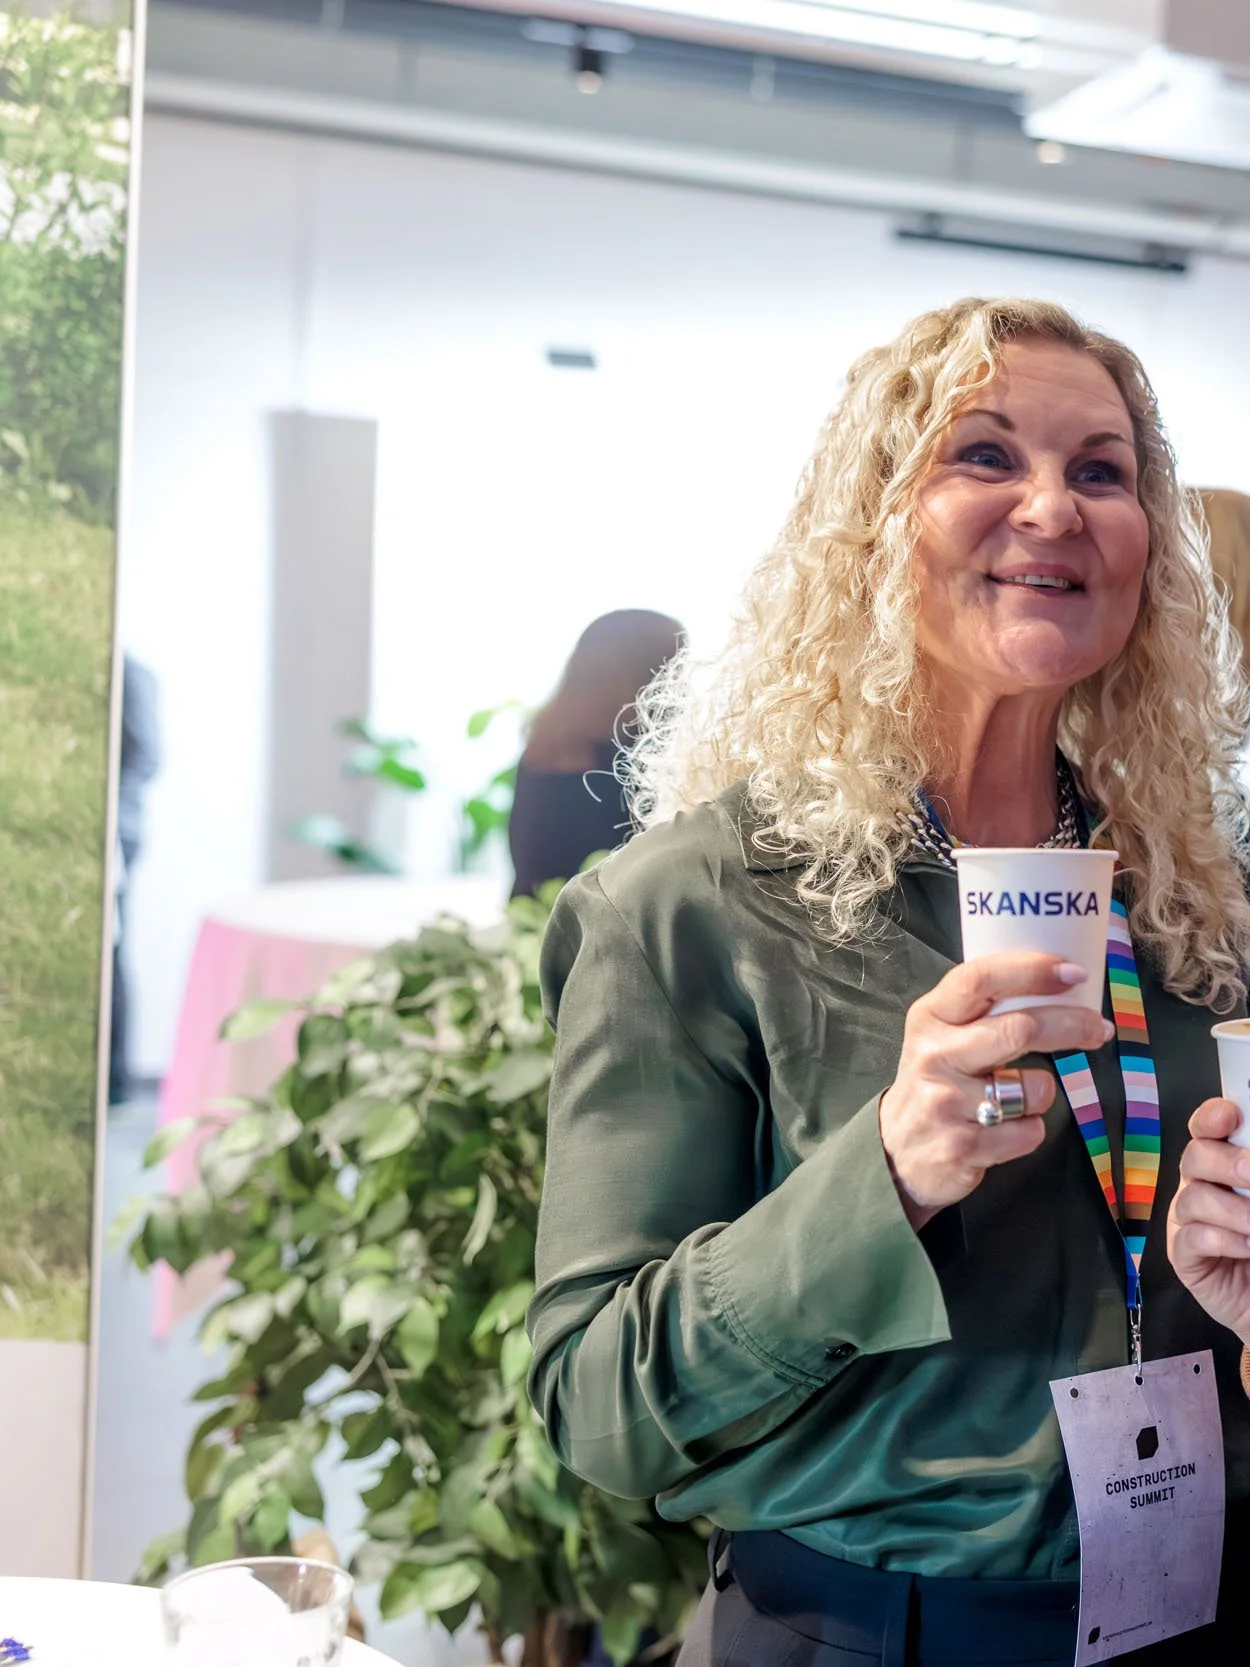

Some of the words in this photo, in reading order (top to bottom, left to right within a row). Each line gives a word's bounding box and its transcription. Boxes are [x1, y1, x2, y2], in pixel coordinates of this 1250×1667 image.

[967, 891, 1099, 917] SKANSKA
[1105, 1462, 1197, 1496] CONSTRUCTION
[1129, 1486, 1176, 1509] SUMMIT
